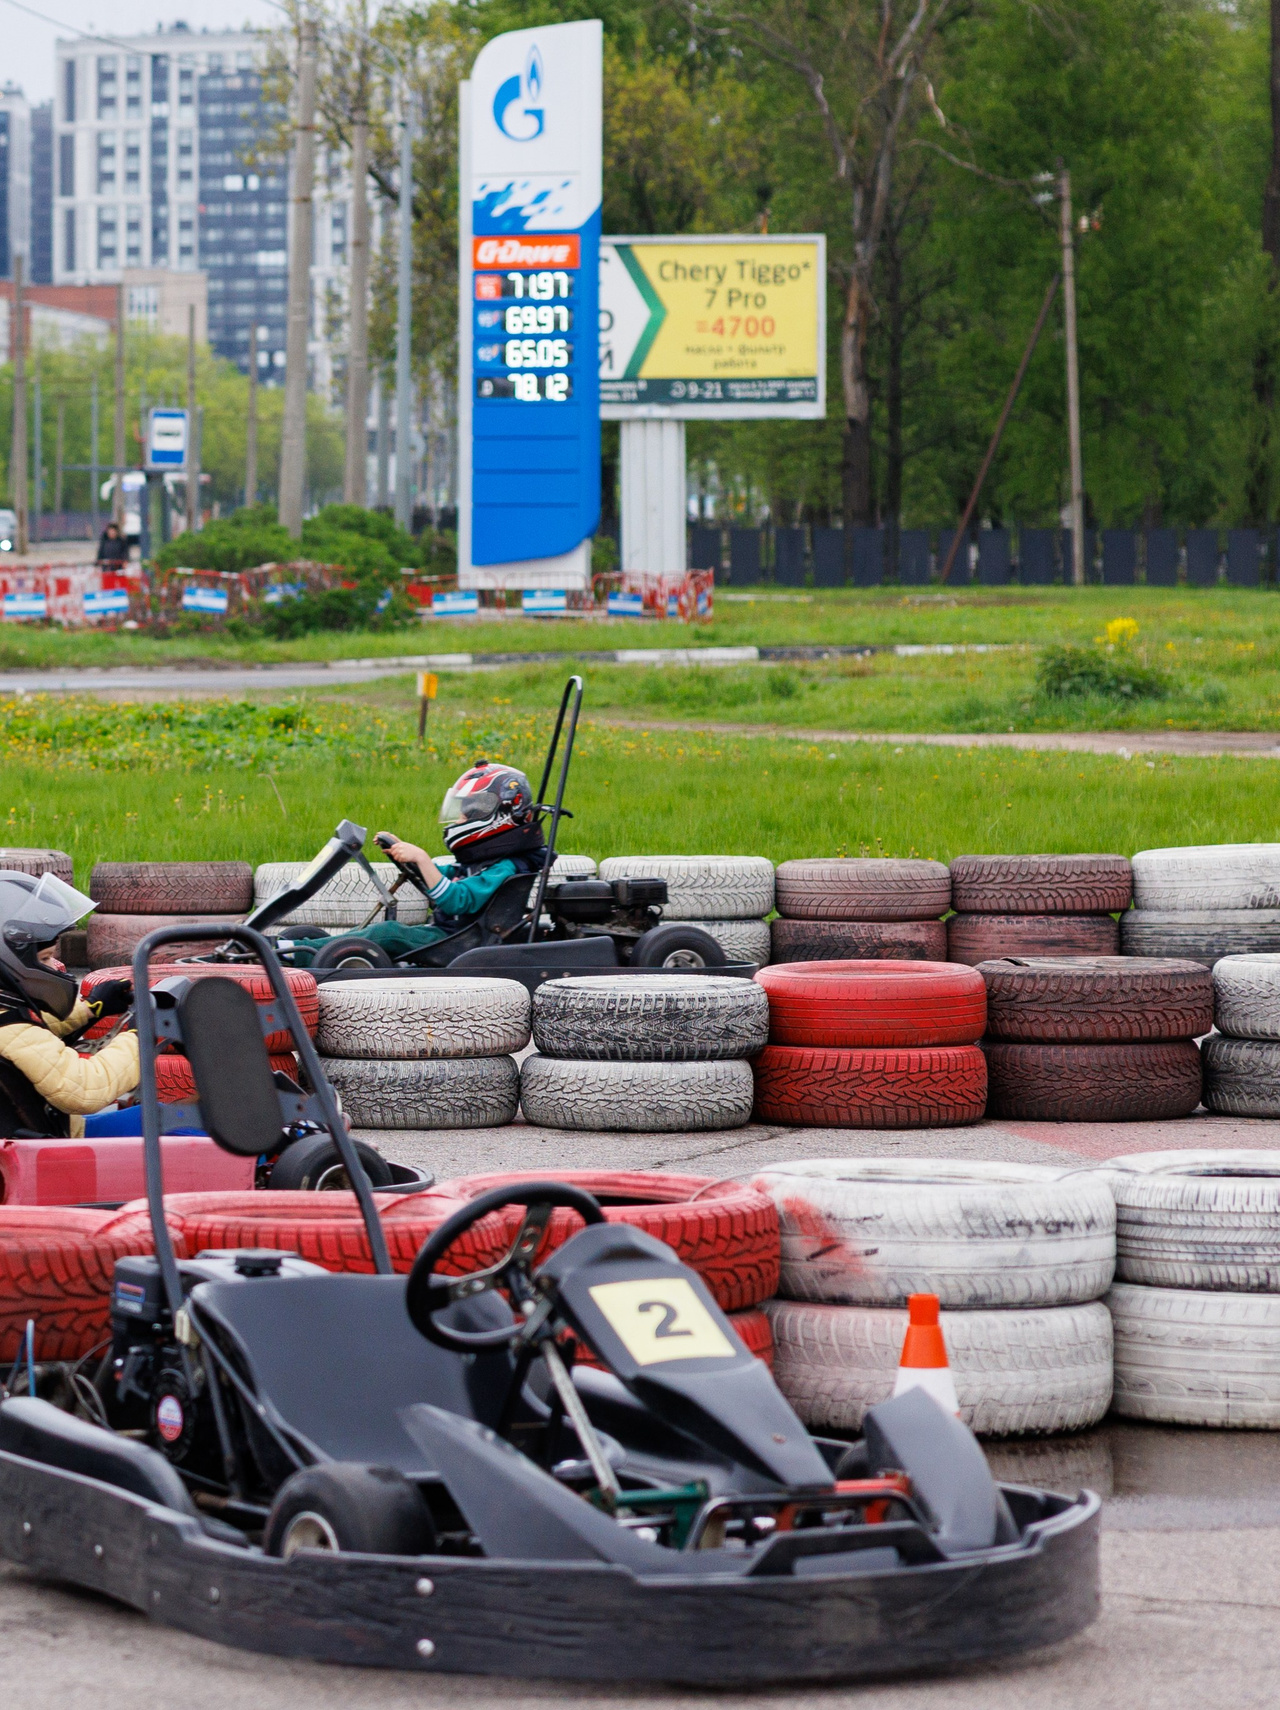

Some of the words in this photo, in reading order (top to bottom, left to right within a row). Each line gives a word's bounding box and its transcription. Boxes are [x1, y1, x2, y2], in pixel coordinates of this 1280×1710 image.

[658, 260, 726, 284] Chery
[705, 288, 717, 309] 7
[728, 288, 767, 309] Pro
[637, 1301, 694, 1338] 2
